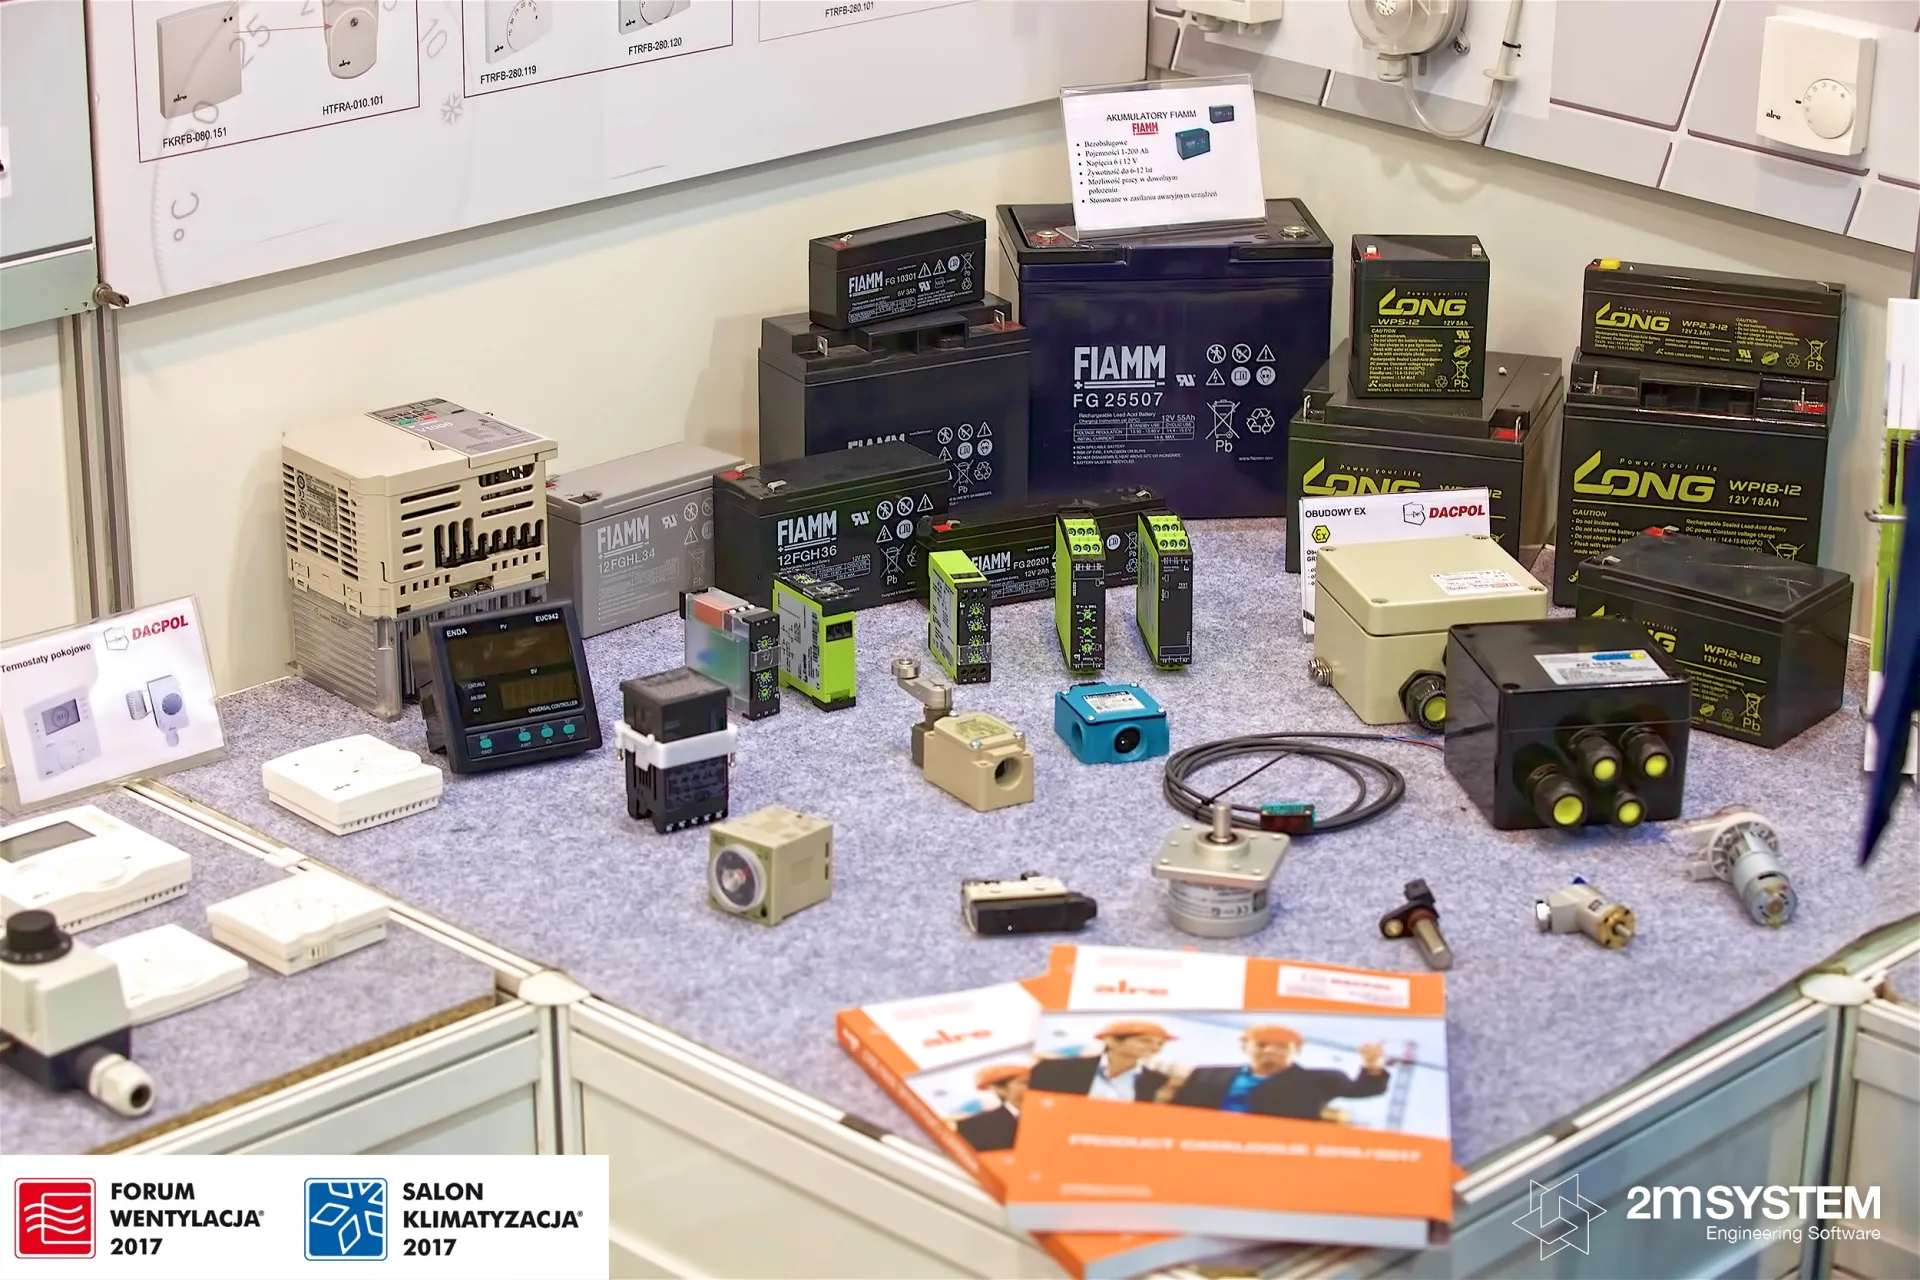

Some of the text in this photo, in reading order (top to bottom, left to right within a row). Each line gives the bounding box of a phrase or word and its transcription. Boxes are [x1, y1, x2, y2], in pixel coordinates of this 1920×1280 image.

[824, 1, 875, 18] FTRFB-280.101
[628, 37, 682, 56] FTRFB-280.120
[480, 65, 537, 84] FTRFB-280.119
[322, 95, 384, 116] HTFRA-010.101
[1106, 110, 1197, 122] AKUMULATORY FIAMM
[1132, 122, 1158, 134] FIAMM
[162, 127, 228, 149] FKRFB-080.151
[849, 271, 917, 294] FIAMM FG 10301
[1378, 287, 1466, 316] LONG
[1595, 301, 1671, 331] LONG
[1682, 320, 1728, 331] WP2.3-12
[1074, 345, 1166, 380] FIAMM
[1807, 360, 1824, 372] Pb
[1454, 379, 1468, 388] Pb
[1073, 392, 1163, 408] FG 25507
[1215, 439, 1232, 453] Pb
[1302, 457, 1421, 496] LONG
[1574, 450, 1716, 503] LONG
[1729, 480, 1802, 496] WP18-12
[1728, 495, 1780, 508] 12V 18Ah
[1305, 507, 1366, 518] OBUDOWY EX
[1429, 504, 1485, 519] DACPOL
[1572, 509, 1607, 517] CAUTION
[597, 515, 649, 553] FIAMM
[777, 510, 837, 546] FIAMM
[599, 548, 655, 574] 12FGHL34
[777, 545, 837, 567] 12FGH36
[972, 551, 1049, 571] FIAMM FG 20201
[887, 575, 898, 585] Pb
[132, 615, 188, 641] DACPOL
[446, 628, 467, 637] ENDA
[1, 642, 91, 673] Termostaty pokojowe
[1703, 655, 1738, 669] 12V 12Ah
[528, 705, 551, 714] UNIVERSAL
[1742, 717, 1761, 732] Pb
